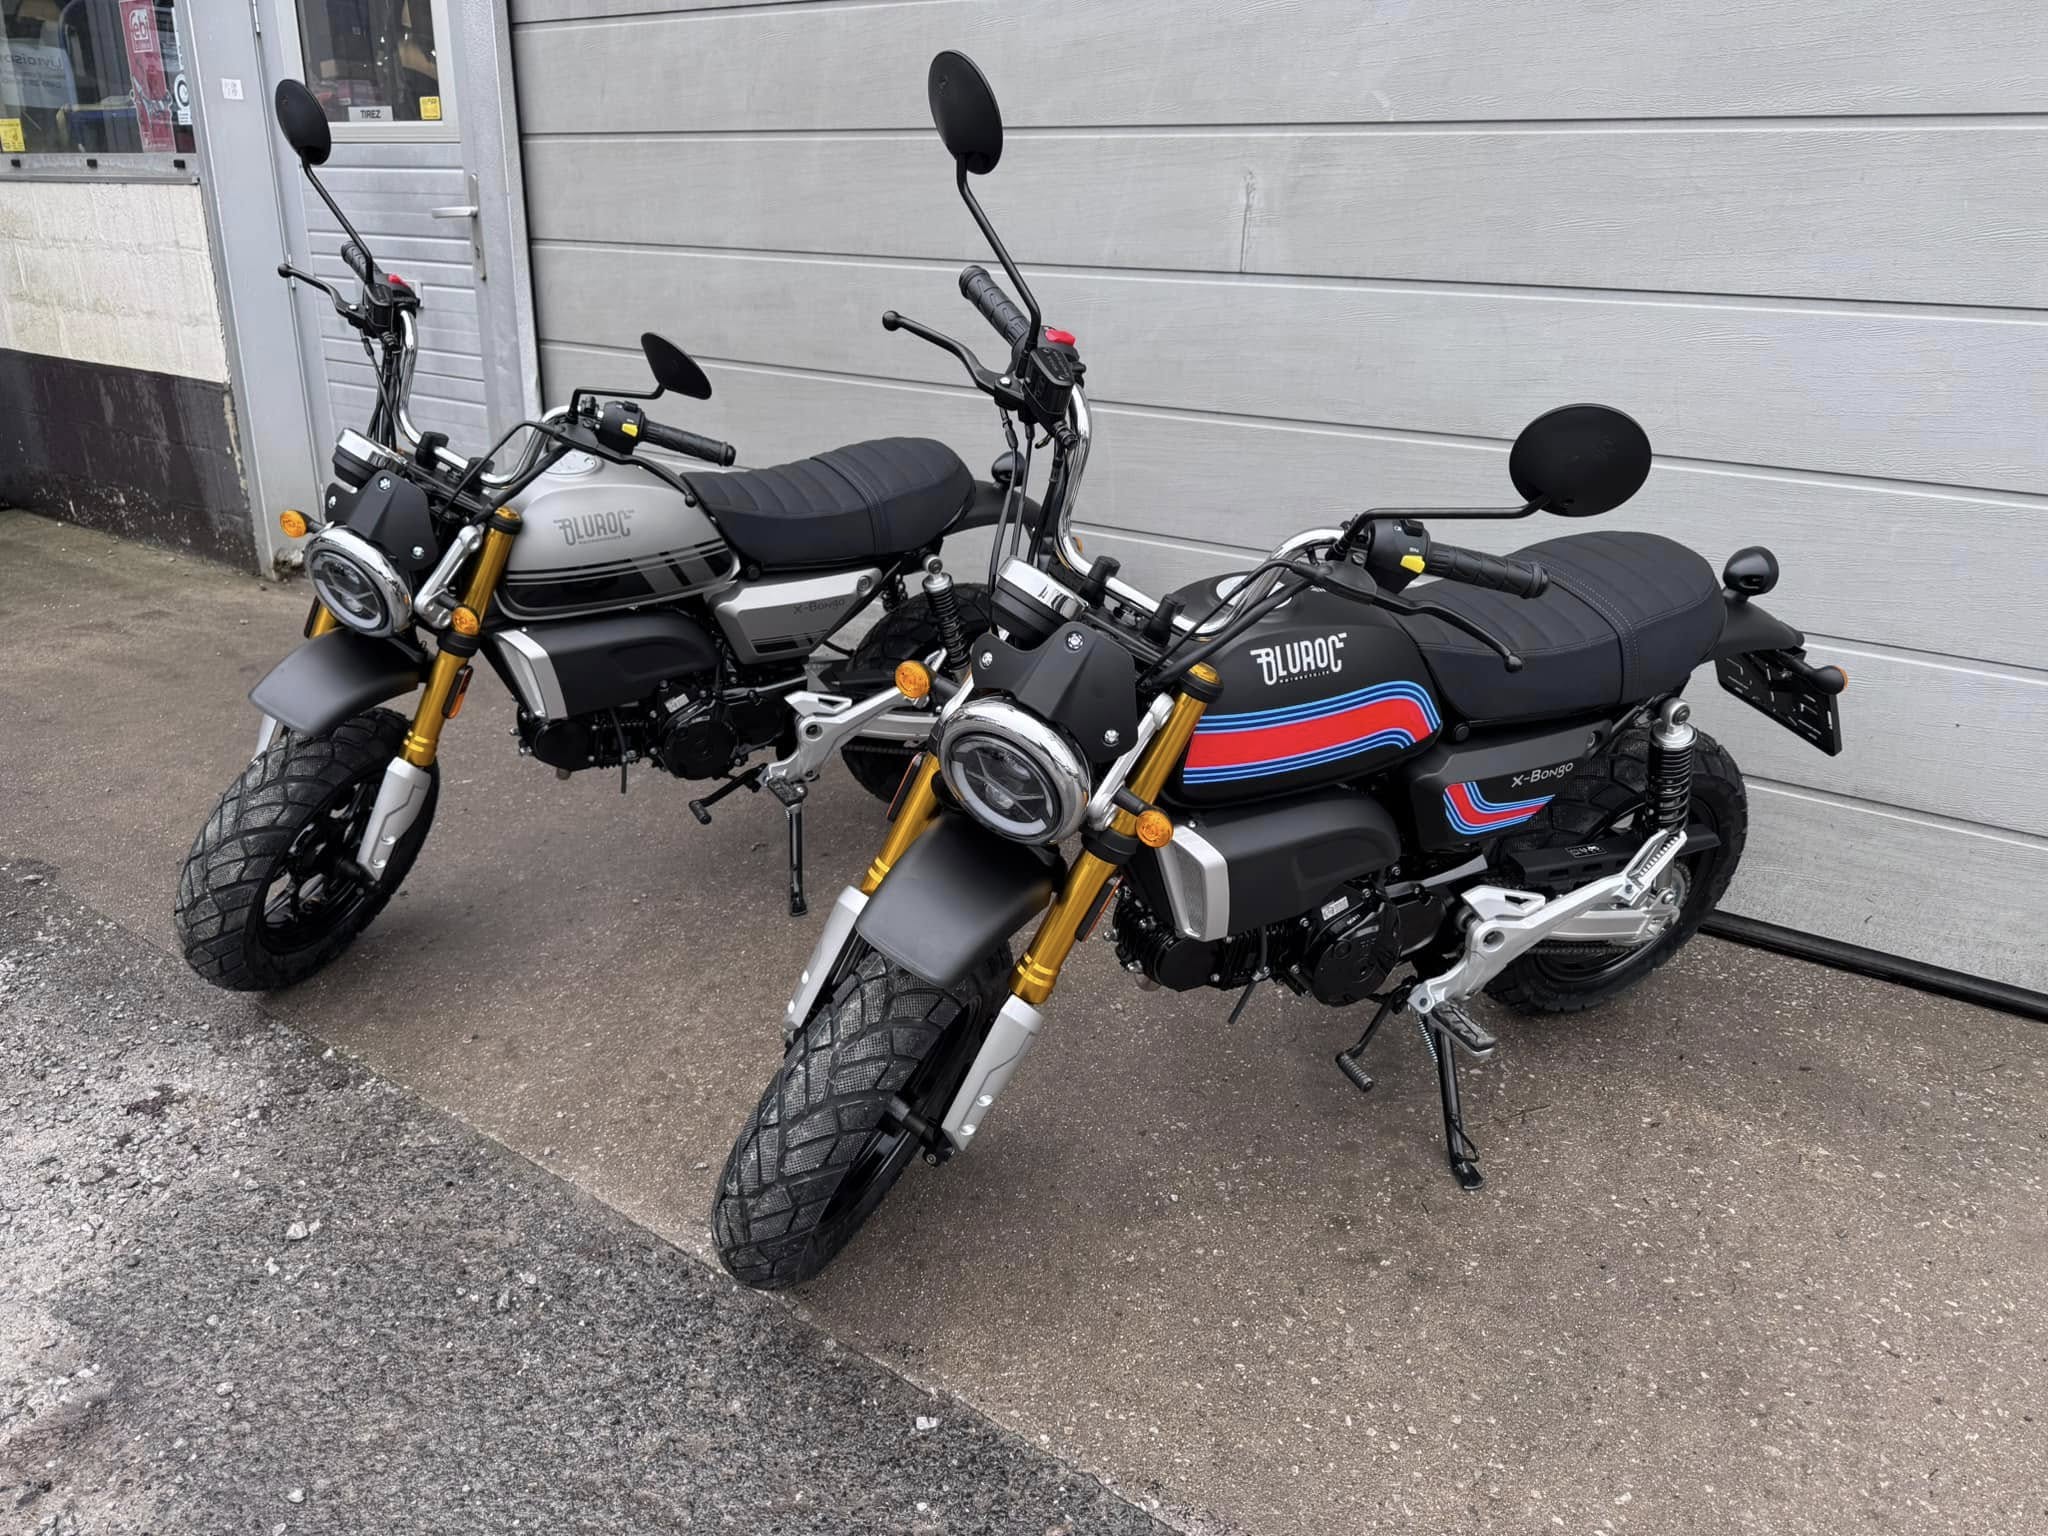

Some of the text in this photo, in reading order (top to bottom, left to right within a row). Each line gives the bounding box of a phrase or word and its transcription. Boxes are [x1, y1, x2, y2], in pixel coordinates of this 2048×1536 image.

[360, 109, 382, 119] TIREZ
[553, 510, 635, 546] BLUROC
[1250, 632, 1347, 685] BLUROC
